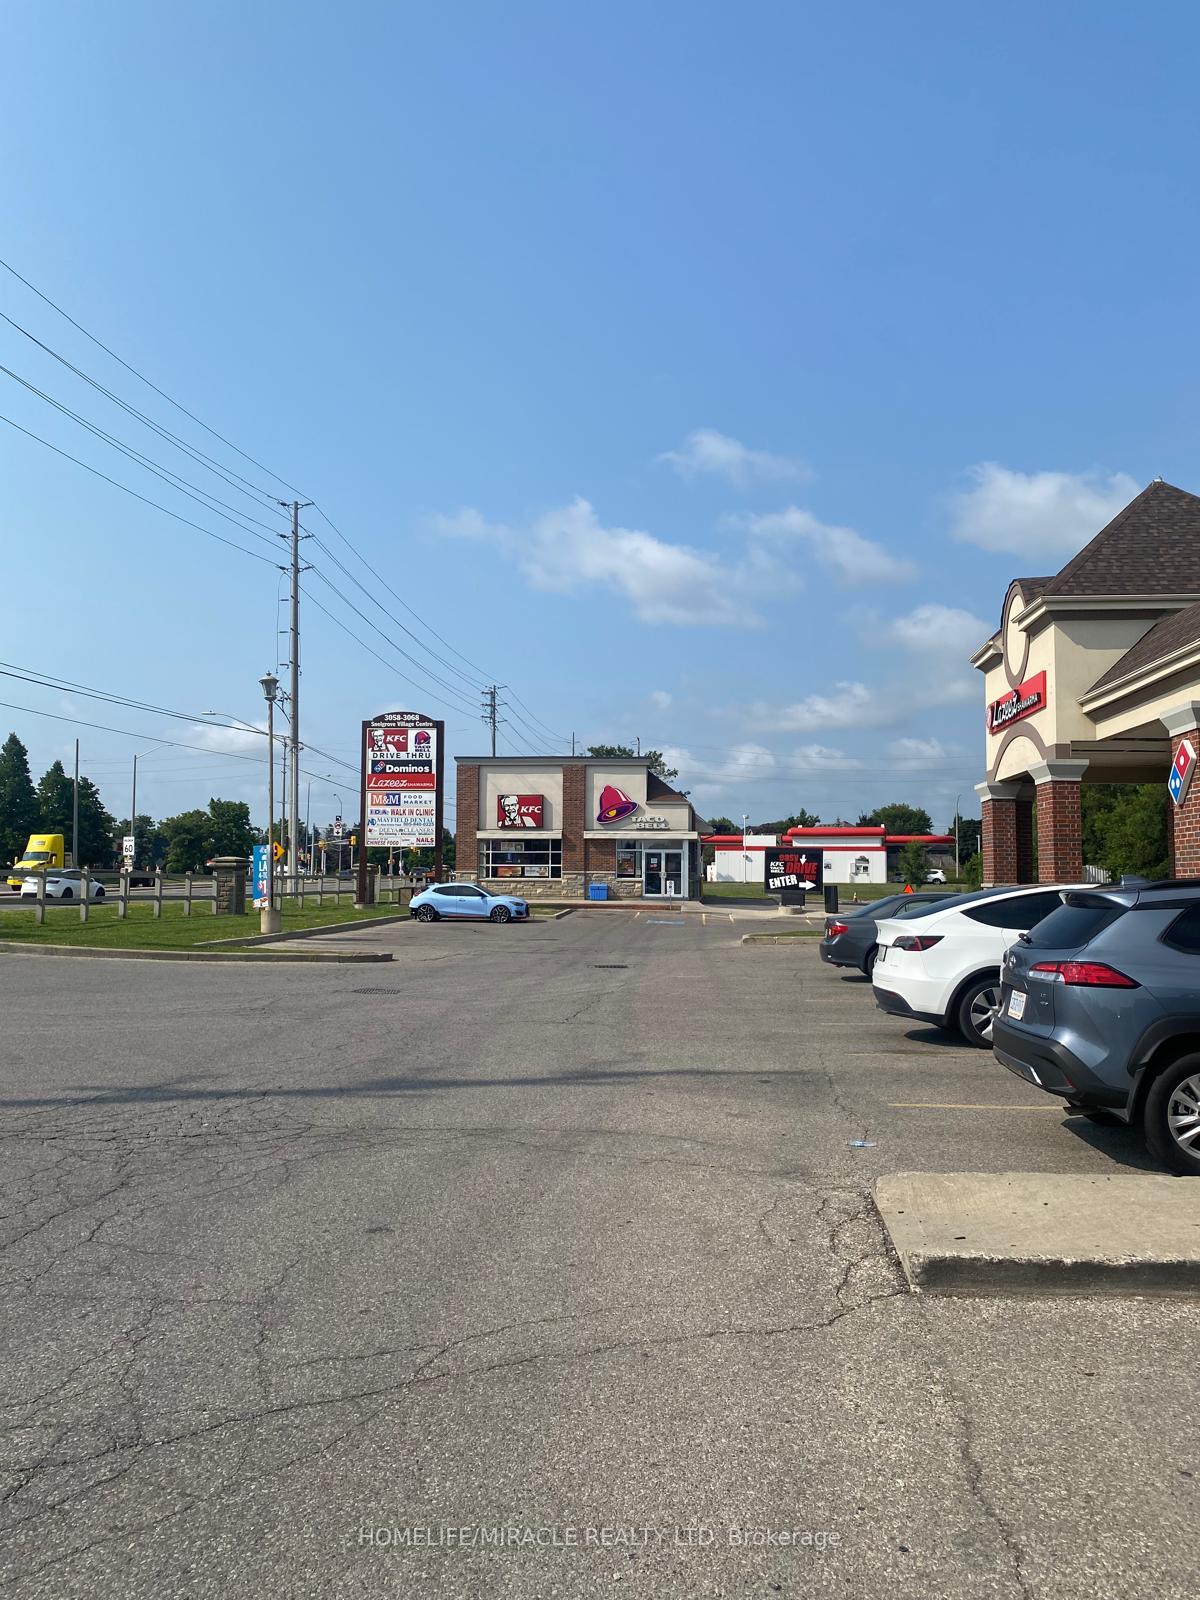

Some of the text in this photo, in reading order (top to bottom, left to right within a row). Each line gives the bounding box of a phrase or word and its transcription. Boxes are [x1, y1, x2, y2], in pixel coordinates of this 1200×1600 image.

[385, 763, 430, 773] Dominos
[368, 777, 407, 787] Lazeez
[372, 794, 400, 805] M&M
[390, 808, 407, 816] WALK
[408, 808, 414, 816] IN
[415, 808, 435, 816] CLINIC
[520, 805, 542, 813] KFC
[124, 844, 134, 853] 60
[786, 862, 818, 874] DRIVE
[768, 874, 798, 889] ENTER
